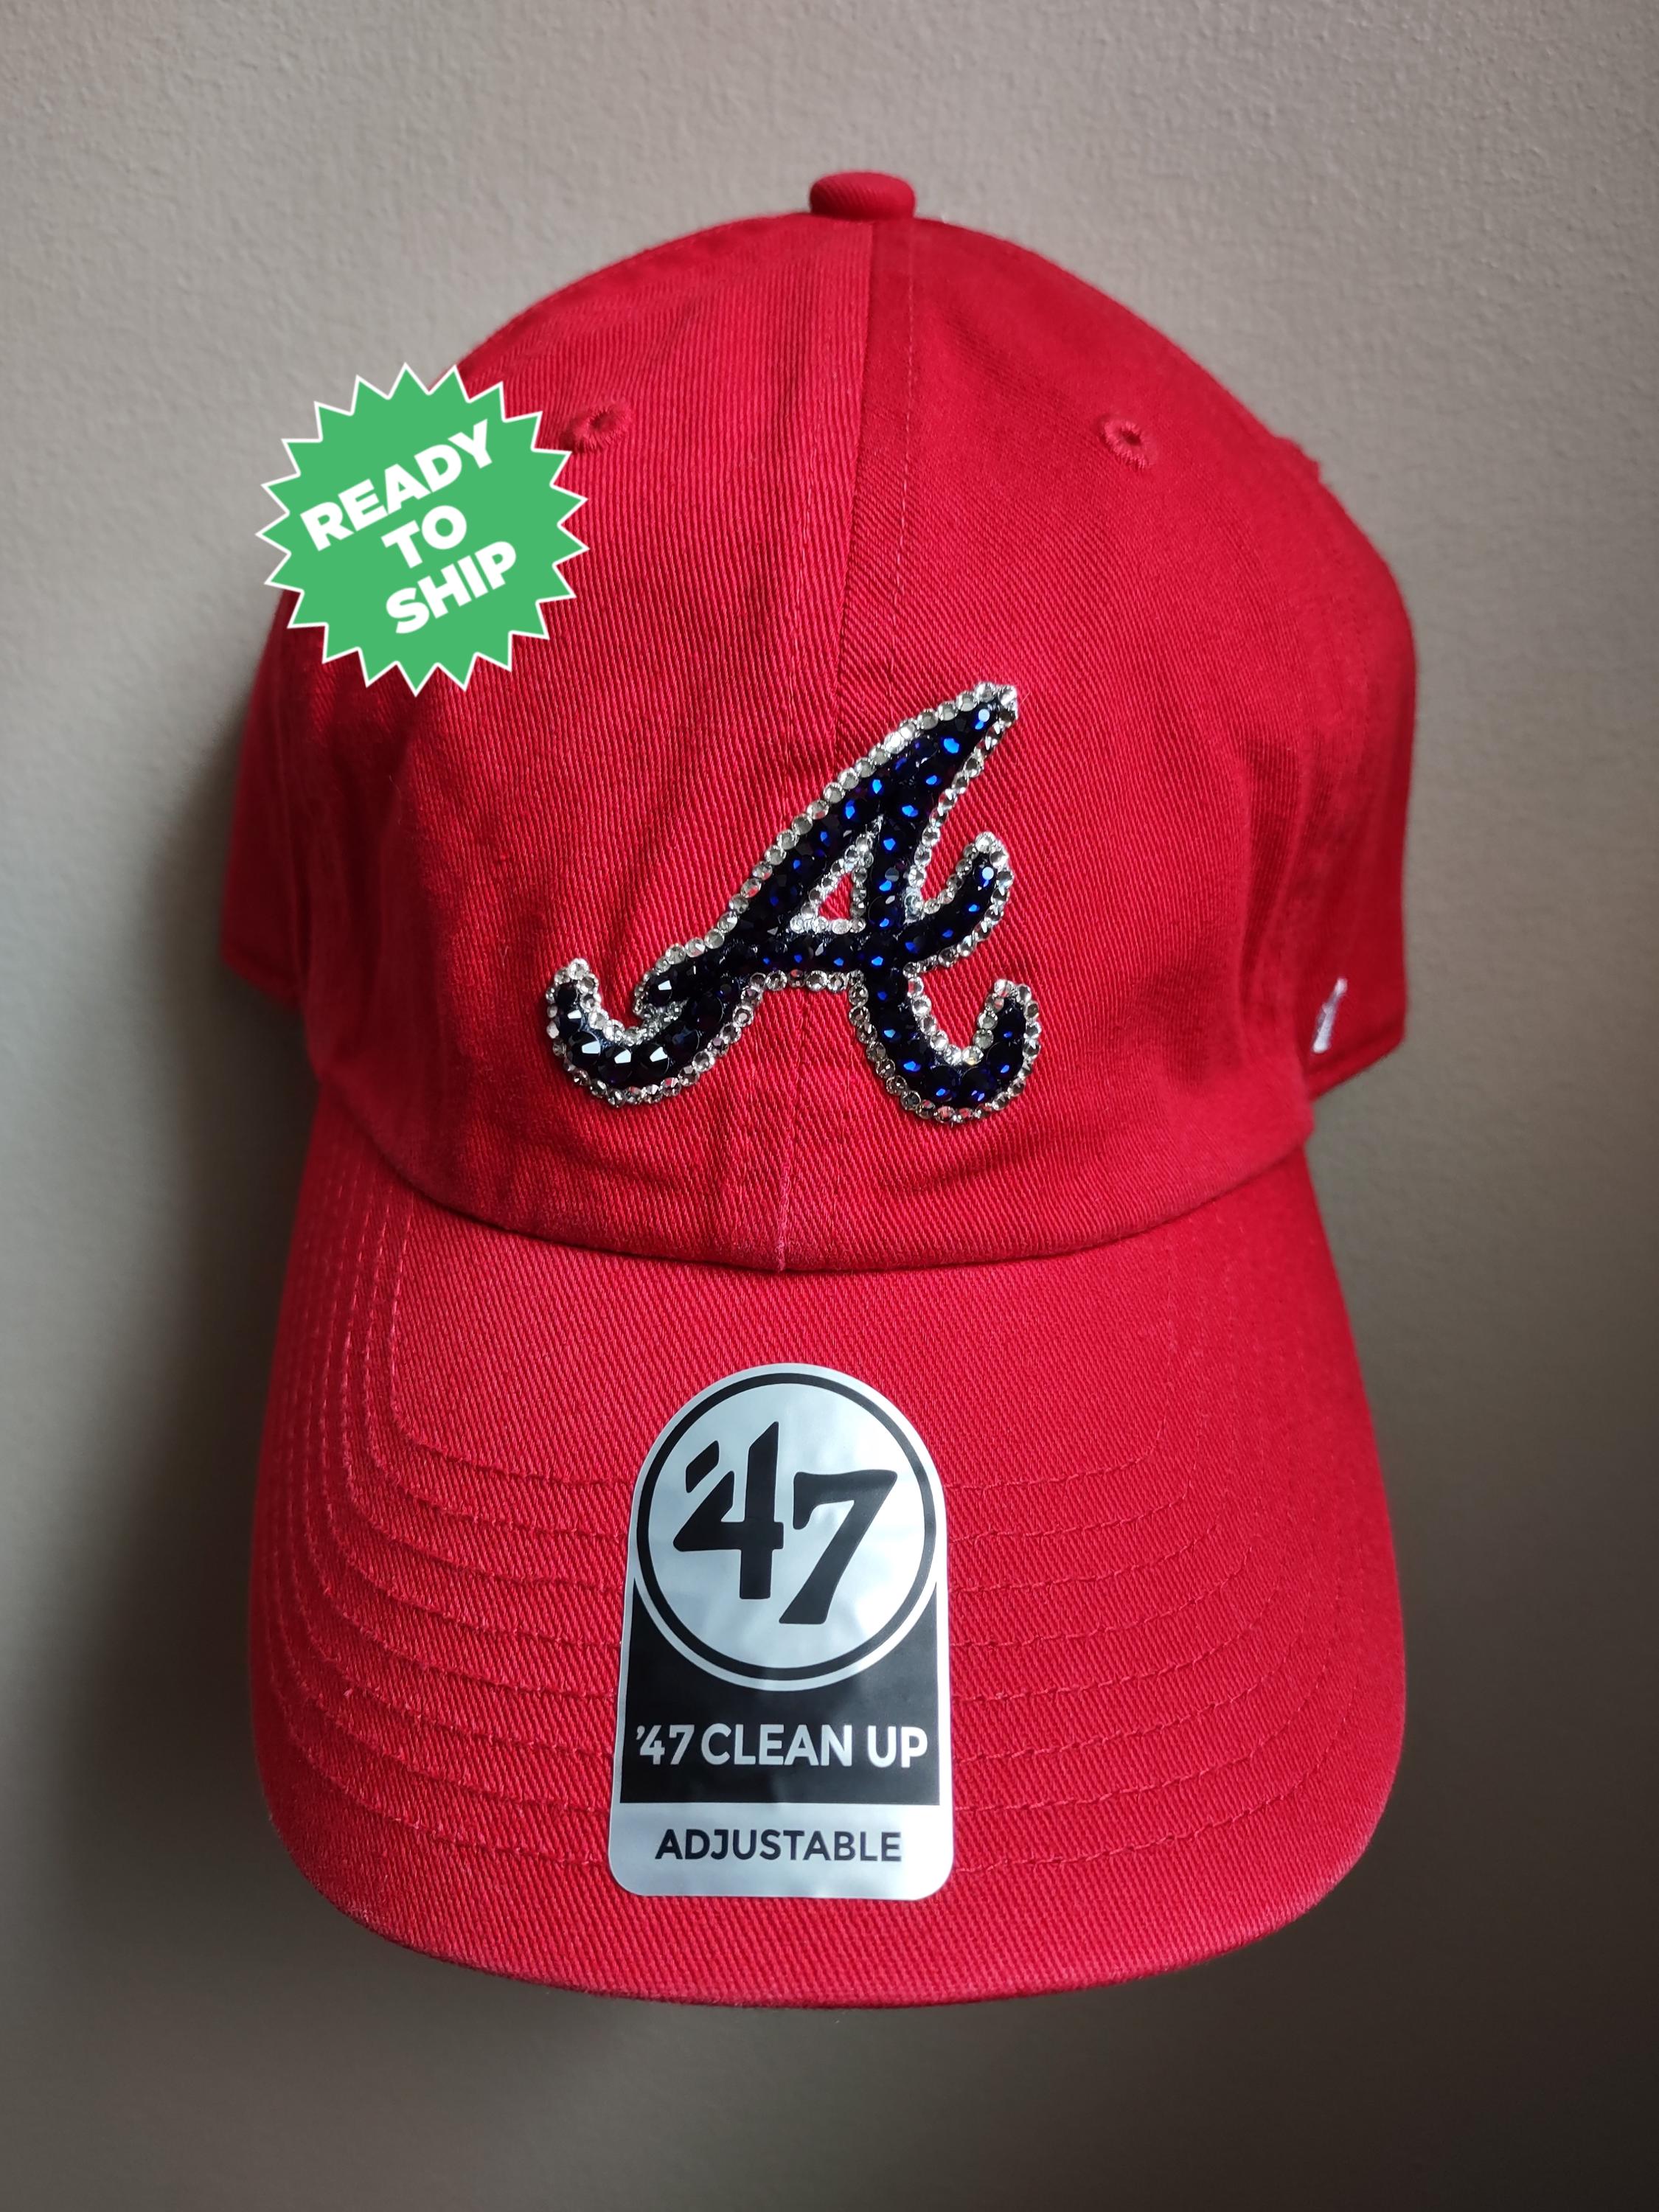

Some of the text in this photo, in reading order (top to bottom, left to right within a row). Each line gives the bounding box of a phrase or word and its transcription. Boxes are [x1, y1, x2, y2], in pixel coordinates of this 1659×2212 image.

[546, 682, 1040, 1126] A
[700, 1723, 852, 1767] CLEAN
[866, 1726, 928, 1769] UP
[655, 1829, 902, 1863] ADJUSTABLE
